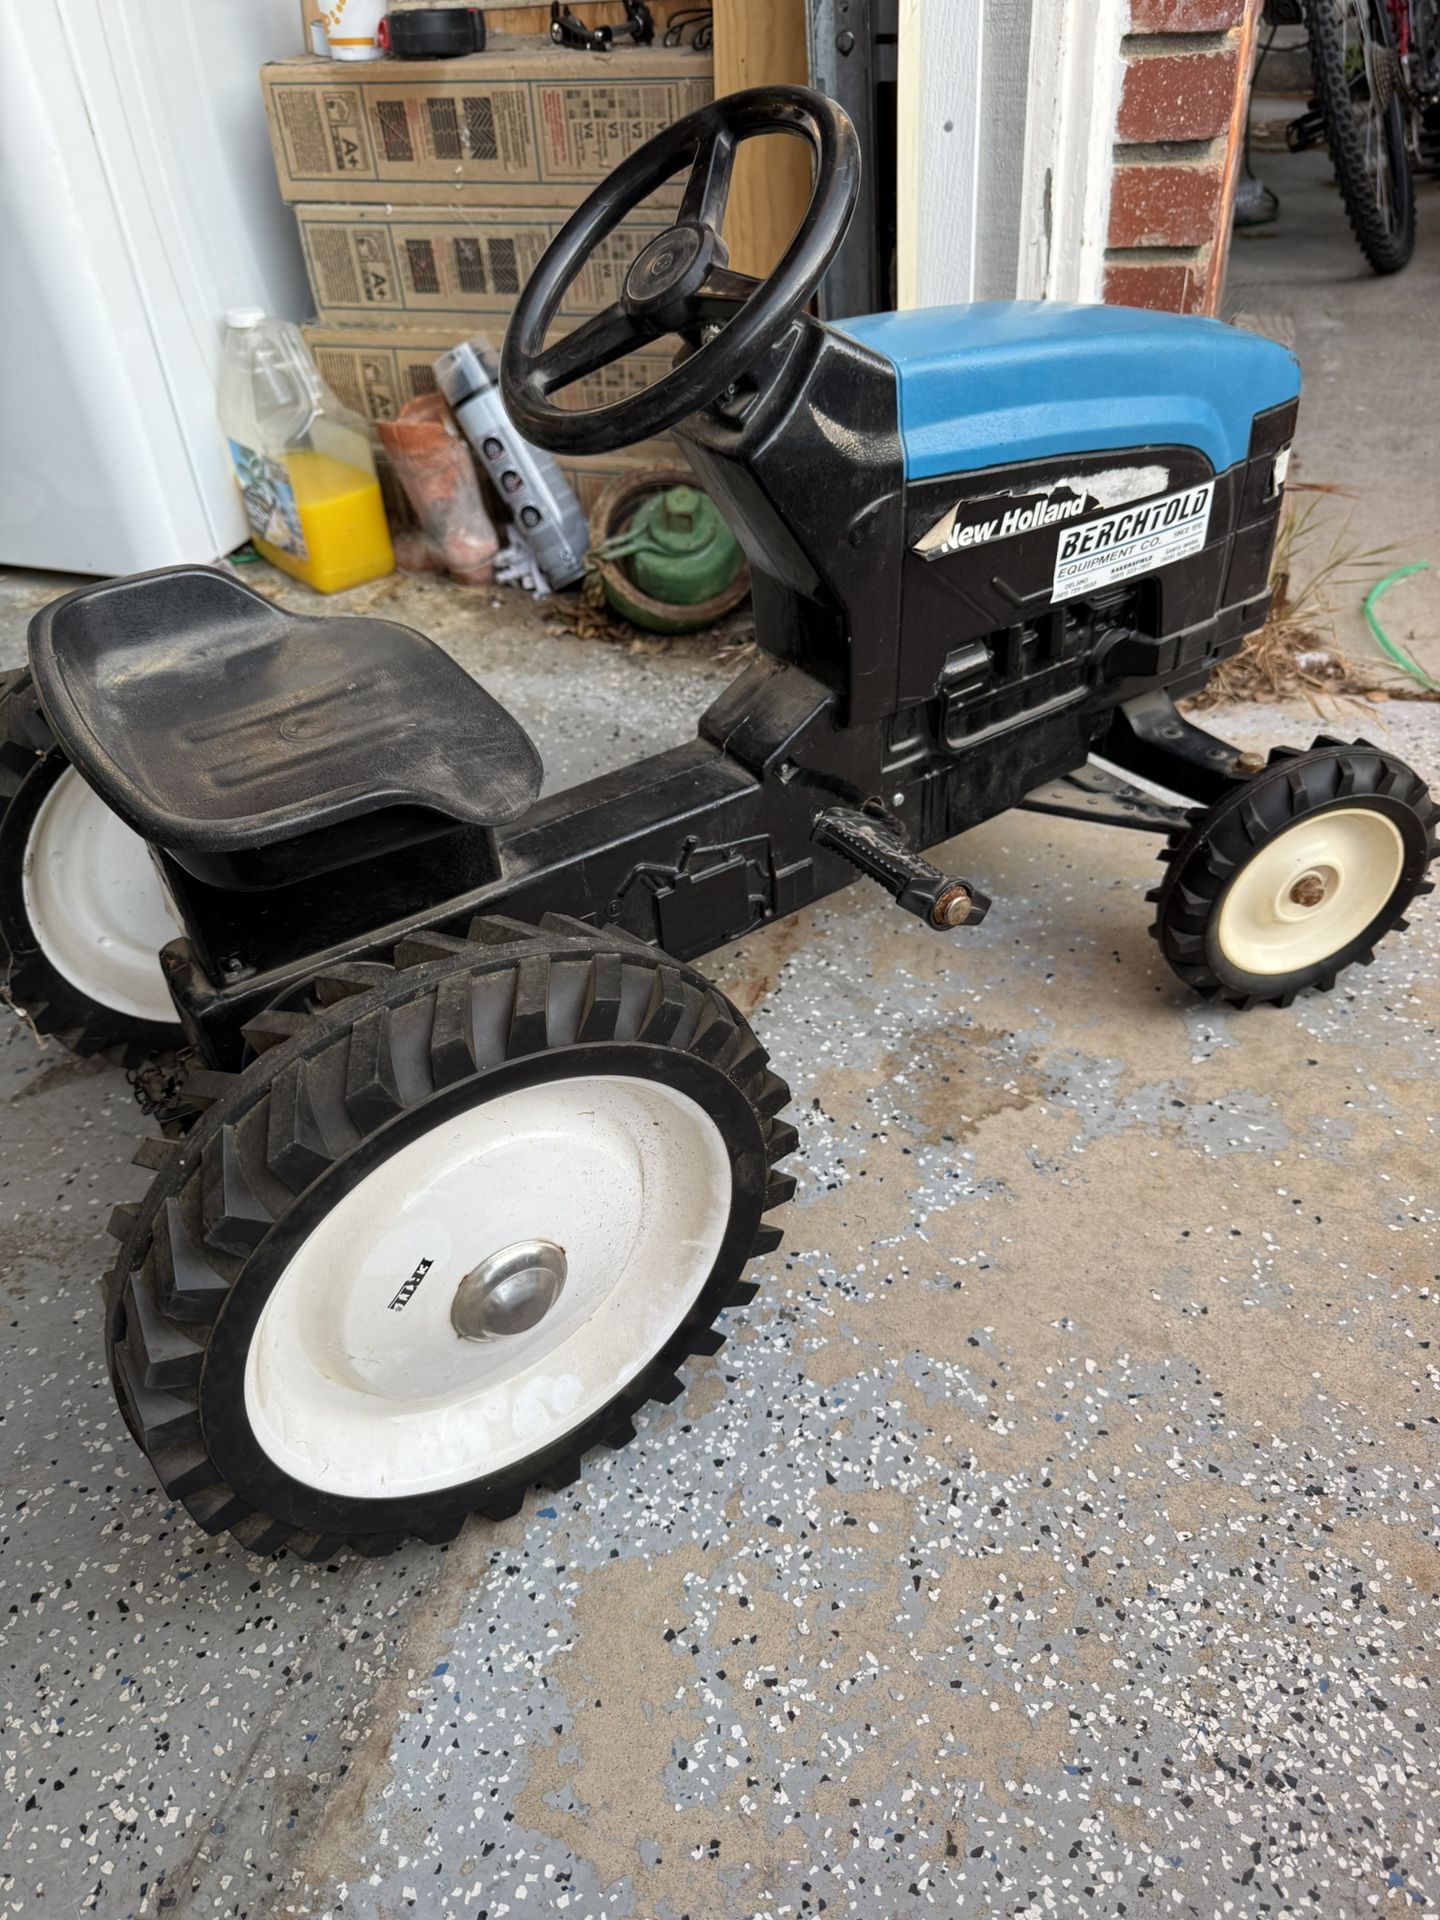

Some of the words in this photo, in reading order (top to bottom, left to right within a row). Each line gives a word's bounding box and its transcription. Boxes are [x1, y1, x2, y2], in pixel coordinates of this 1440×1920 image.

[341, 138, 359, 168] A+
[940, 519, 999, 553] New
[1000, 490, 1088, 537] Holland
[1060, 487, 1209, 561] BERCHTOLD
[1057, 544, 1137, 579] EQUIPMENT
[1140, 536, 1162, 551] CO.
[1110, 555, 1153, 574] BAKERSFIELD
[1064, 577, 1088, 590] DELANO
[387, 1257, 434, 1310] ERTL
